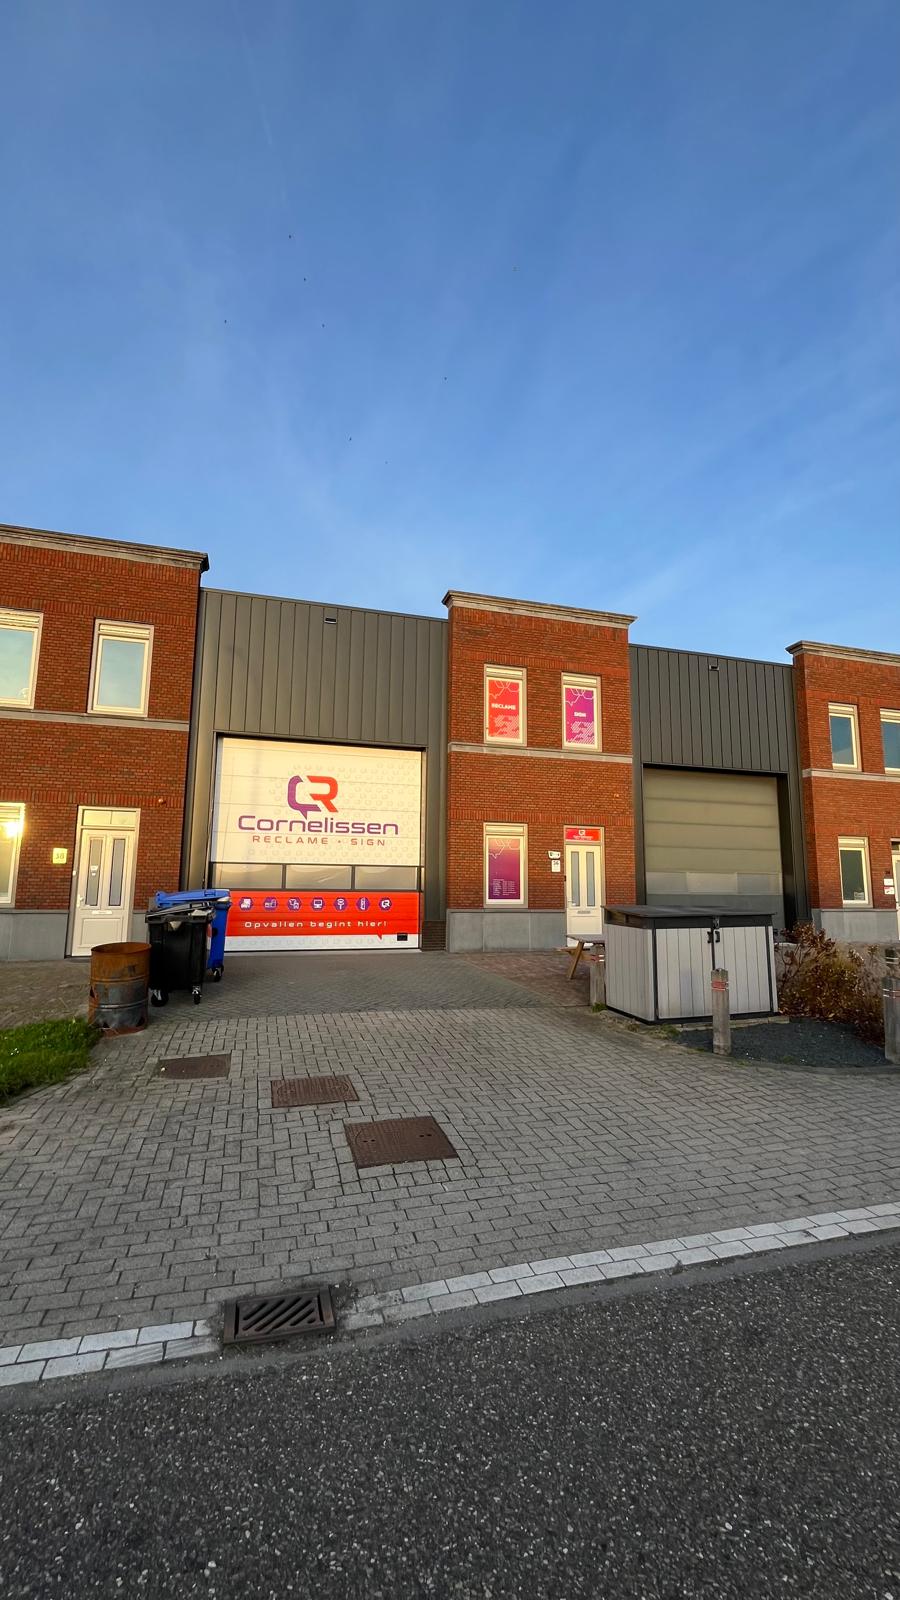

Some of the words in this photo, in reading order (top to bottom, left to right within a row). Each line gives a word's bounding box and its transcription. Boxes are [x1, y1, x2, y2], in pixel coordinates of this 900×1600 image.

[238, 815, 399, 835] Cornelissen
[252, 835, 329, 844] RECLAME
[351, 838, 385, 846] SIGN
[310, 921, 351, 929] begint
[357, 920, 387, 928] hier!
